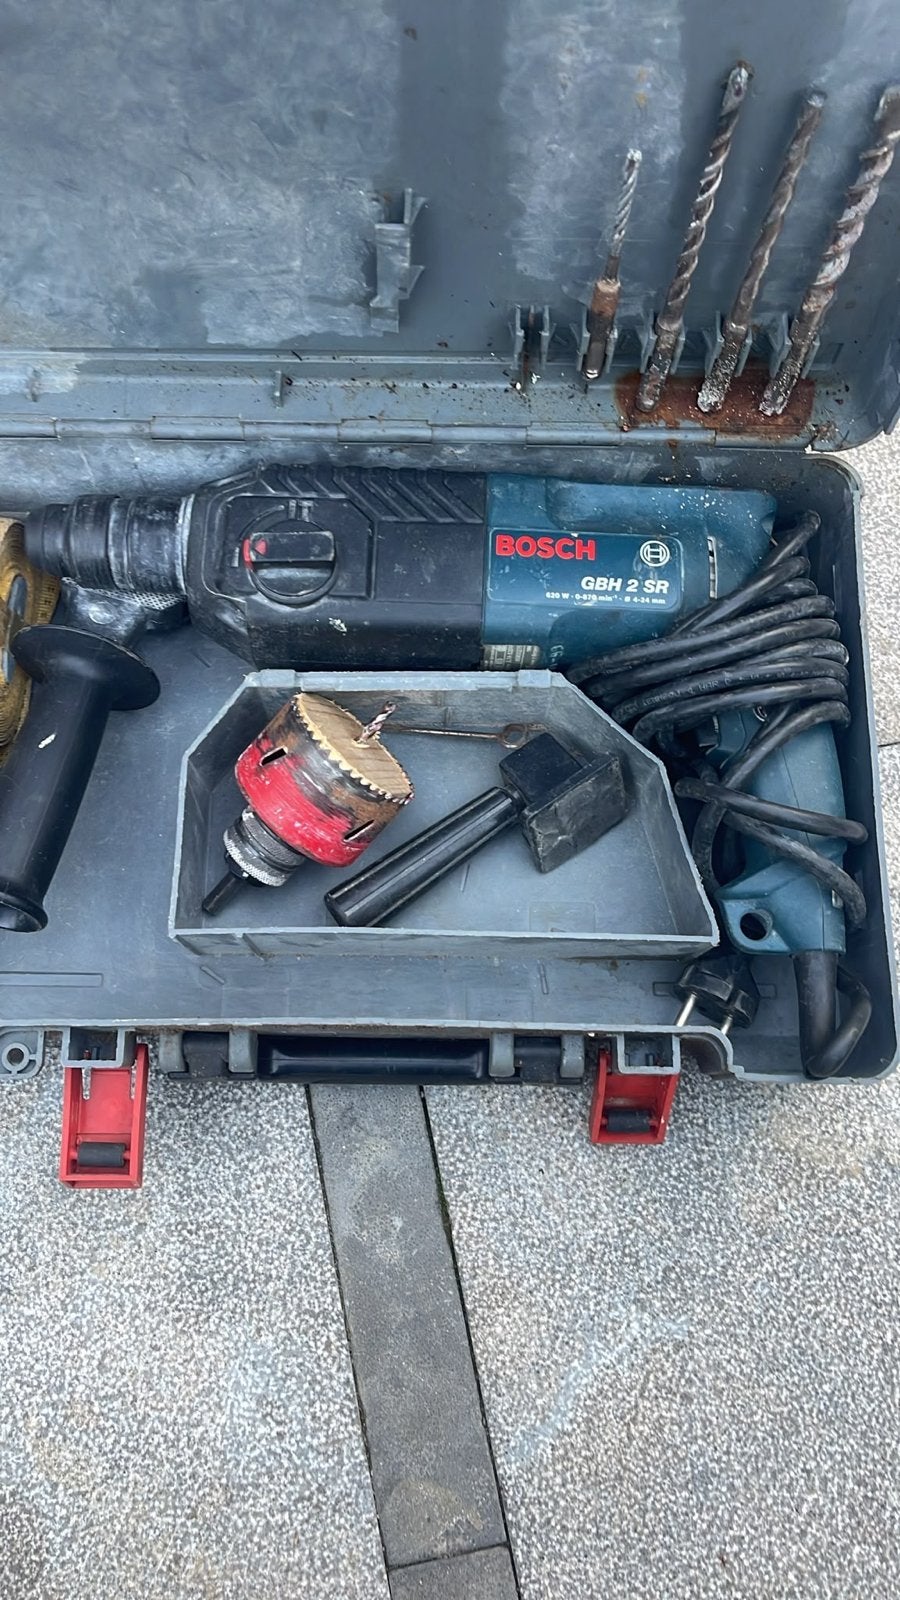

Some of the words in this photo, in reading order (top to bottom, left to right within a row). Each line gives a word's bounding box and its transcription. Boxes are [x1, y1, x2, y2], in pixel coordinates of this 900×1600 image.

[495, 534, 596, 560] BOSCH
[581, 576, 623, 592] GBH
[626, 578, 639, 593] 2
[643, 580, 670, 594] SR
